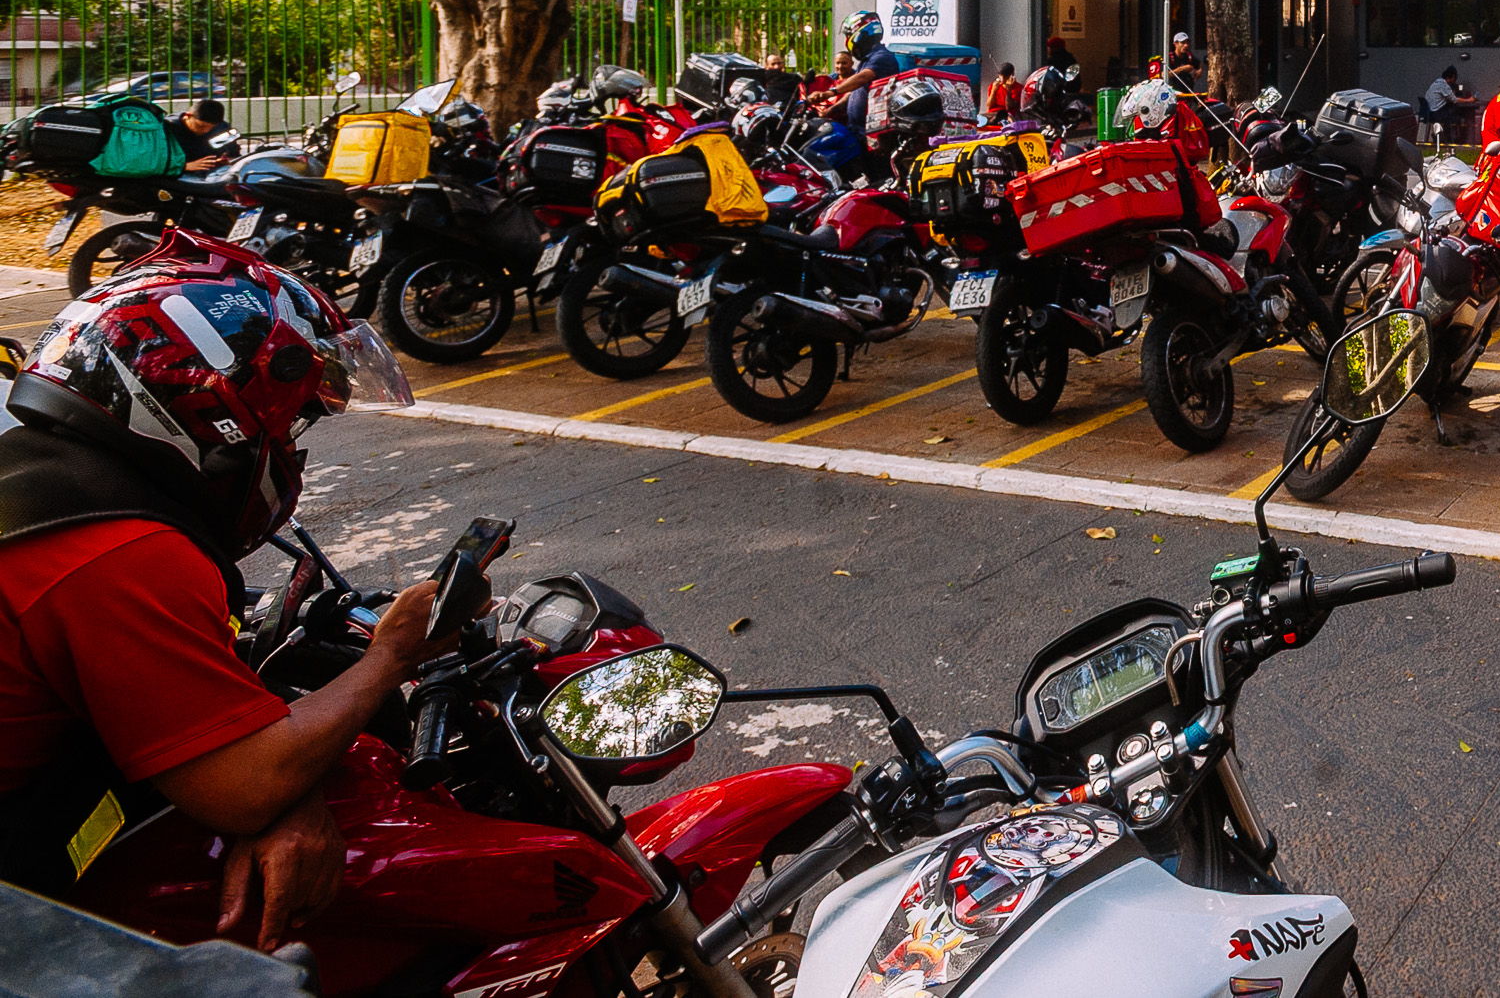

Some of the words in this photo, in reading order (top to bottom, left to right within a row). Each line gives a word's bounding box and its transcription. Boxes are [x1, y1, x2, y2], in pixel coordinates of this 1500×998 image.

[891, 28, 937, 37] MOTOBOY
[954, 290, 986, 305] 4E36
[212, 418, 248, 445] G8
[527, 907, 588, 923] HONDA
